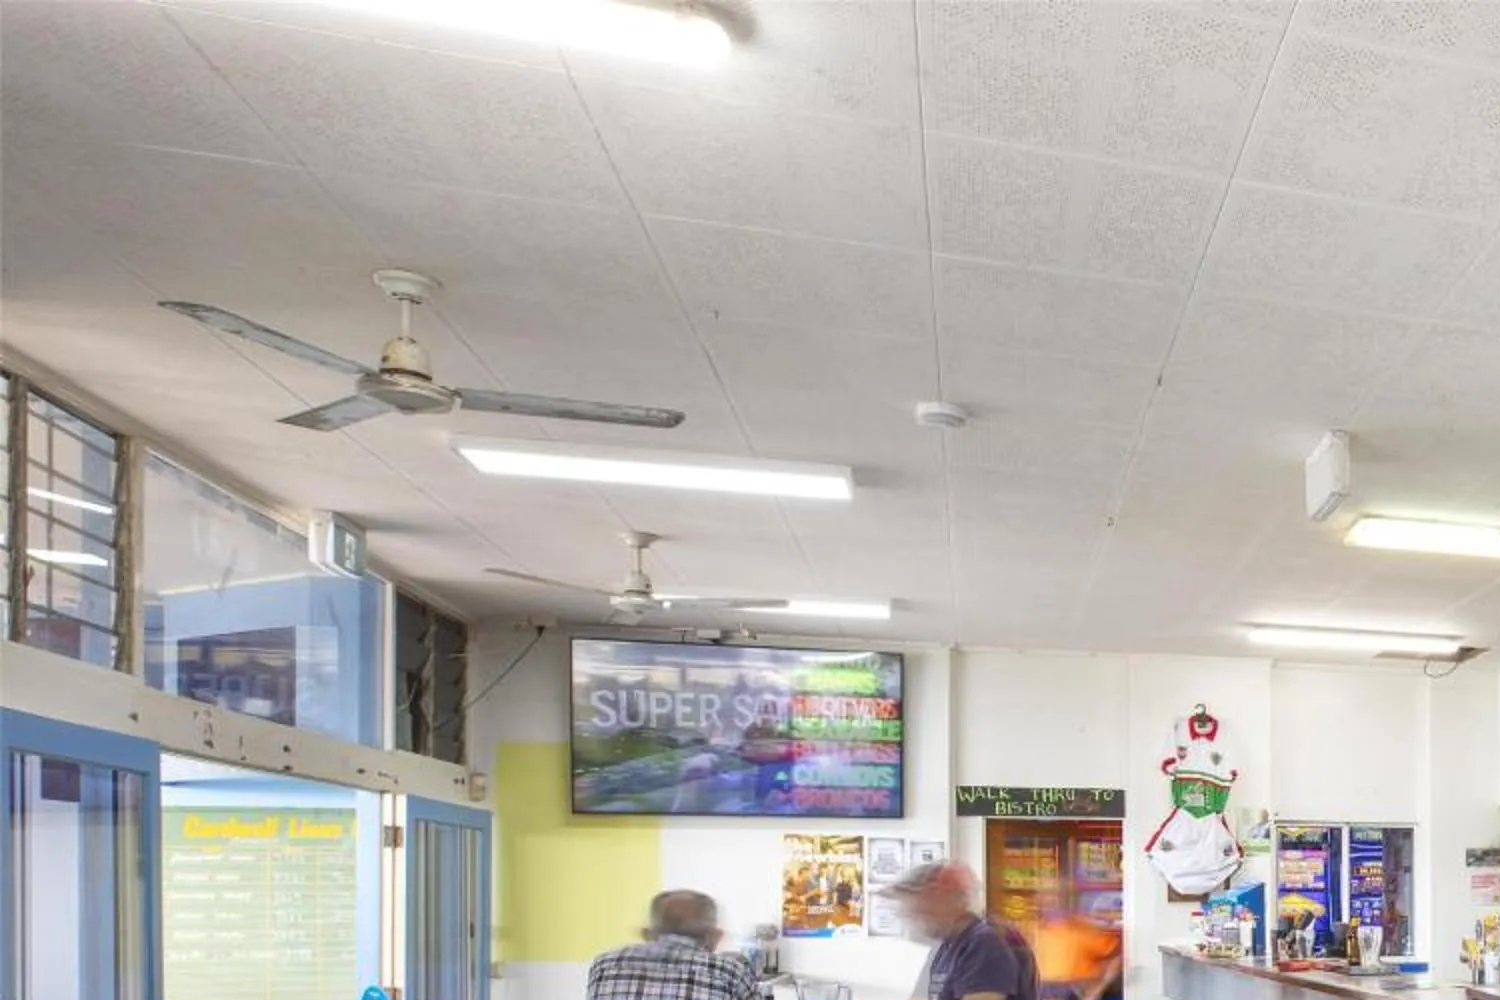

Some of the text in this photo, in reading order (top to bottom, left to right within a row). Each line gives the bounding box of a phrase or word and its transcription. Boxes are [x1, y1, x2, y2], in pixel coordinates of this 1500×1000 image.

[589, 689, 723, 730] SUPER
[957, 786, 1116, 802] WALK THRU TO
[994, 801, 1058, 816] BISTRO
